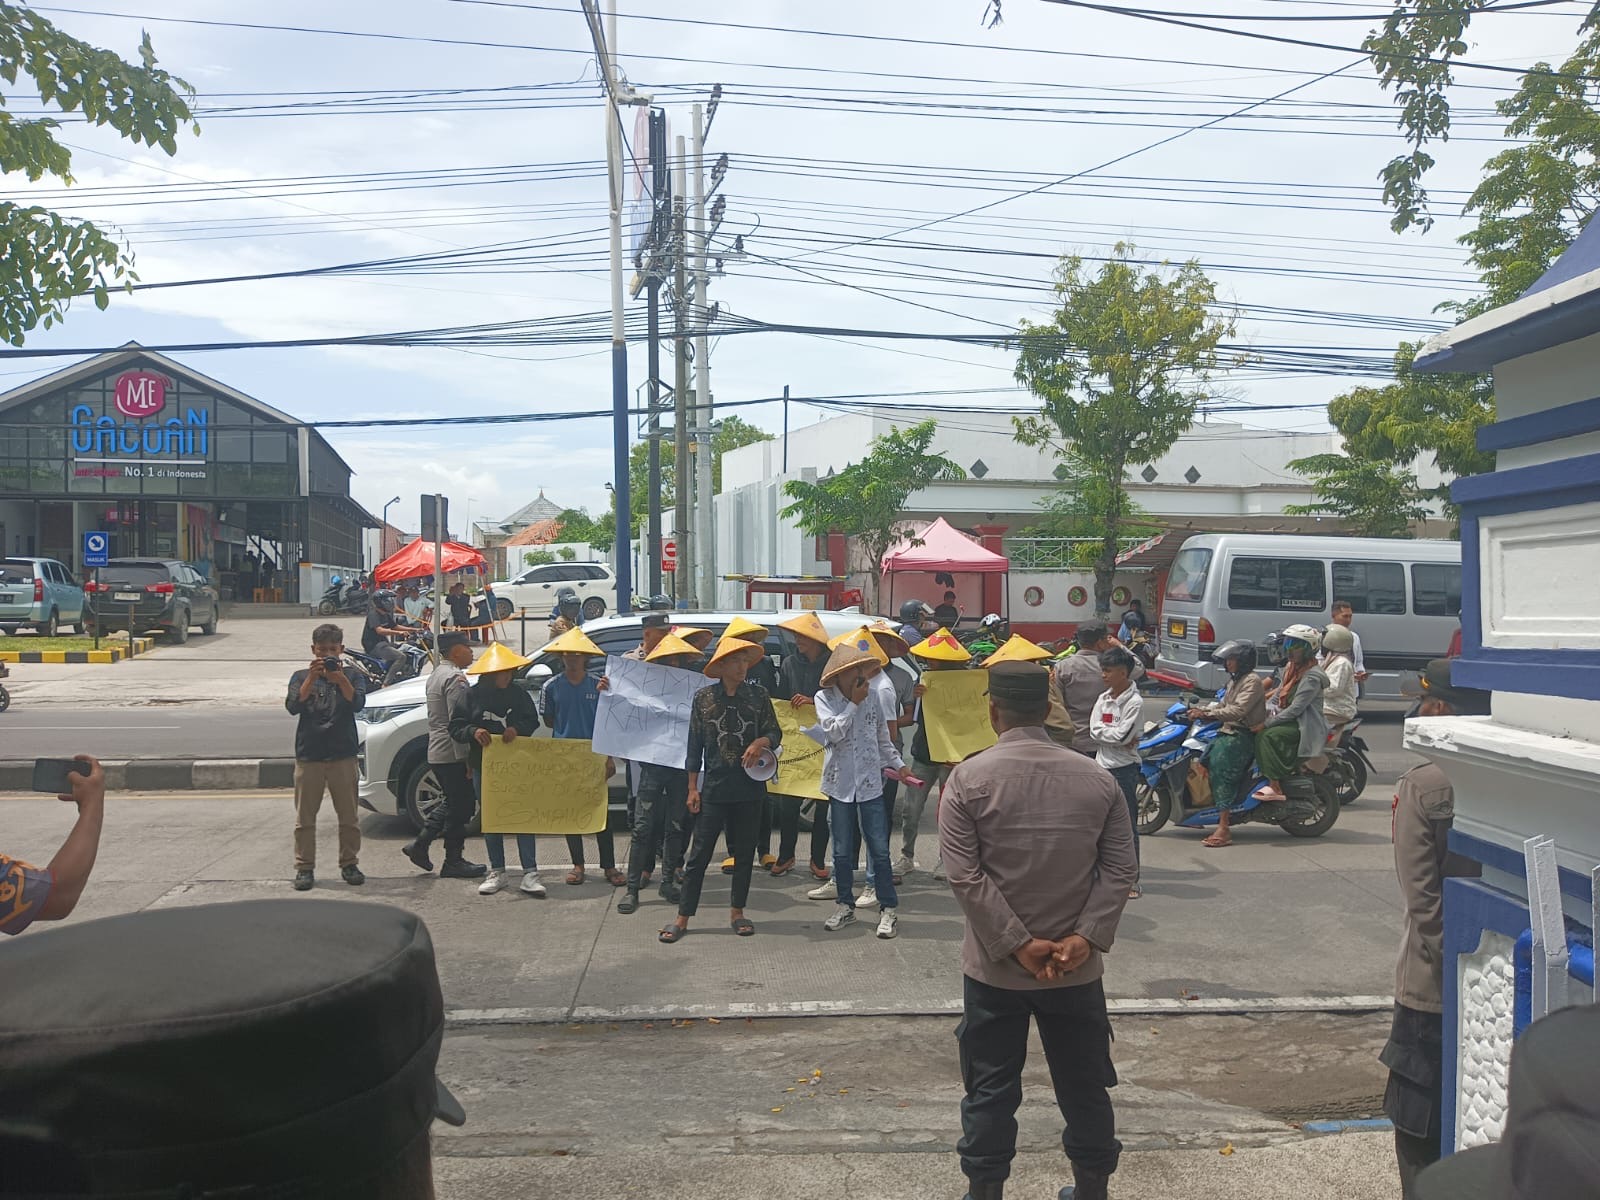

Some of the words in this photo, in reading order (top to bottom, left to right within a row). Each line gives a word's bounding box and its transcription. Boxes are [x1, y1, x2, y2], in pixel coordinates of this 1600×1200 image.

[72, 404, 208, 456] GACOAN
[124, 466, 144, 477] No.
[148, 467, 154, 478] 1
[157, 468, 165, 478] di
[167, 469, 206, 479] Indonesia
